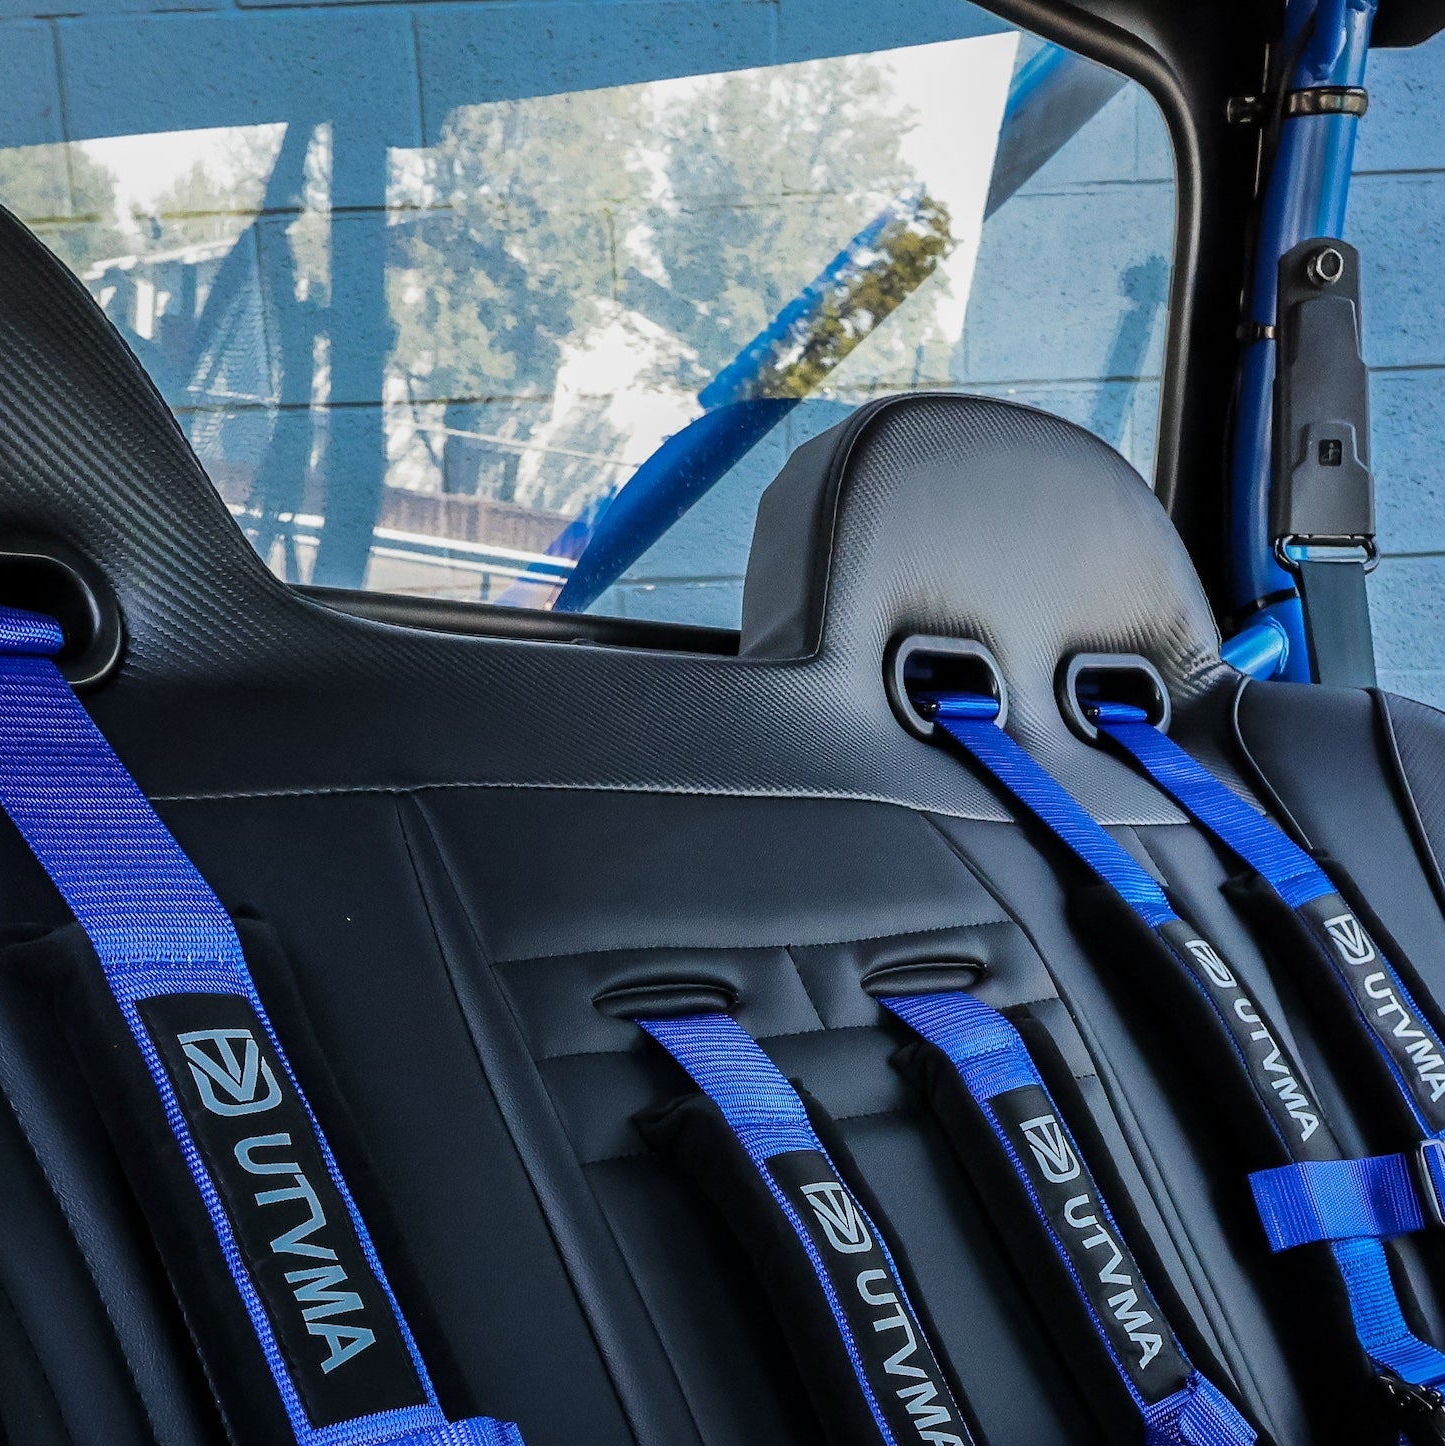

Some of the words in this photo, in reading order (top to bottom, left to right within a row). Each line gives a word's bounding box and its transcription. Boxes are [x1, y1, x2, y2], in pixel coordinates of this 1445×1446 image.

[1234, 998, 1319, 1143] UTVMA
[234, 1132, 376, 1375] UTVMA
[1064, 1194, 1163, 1369] UTVMA
